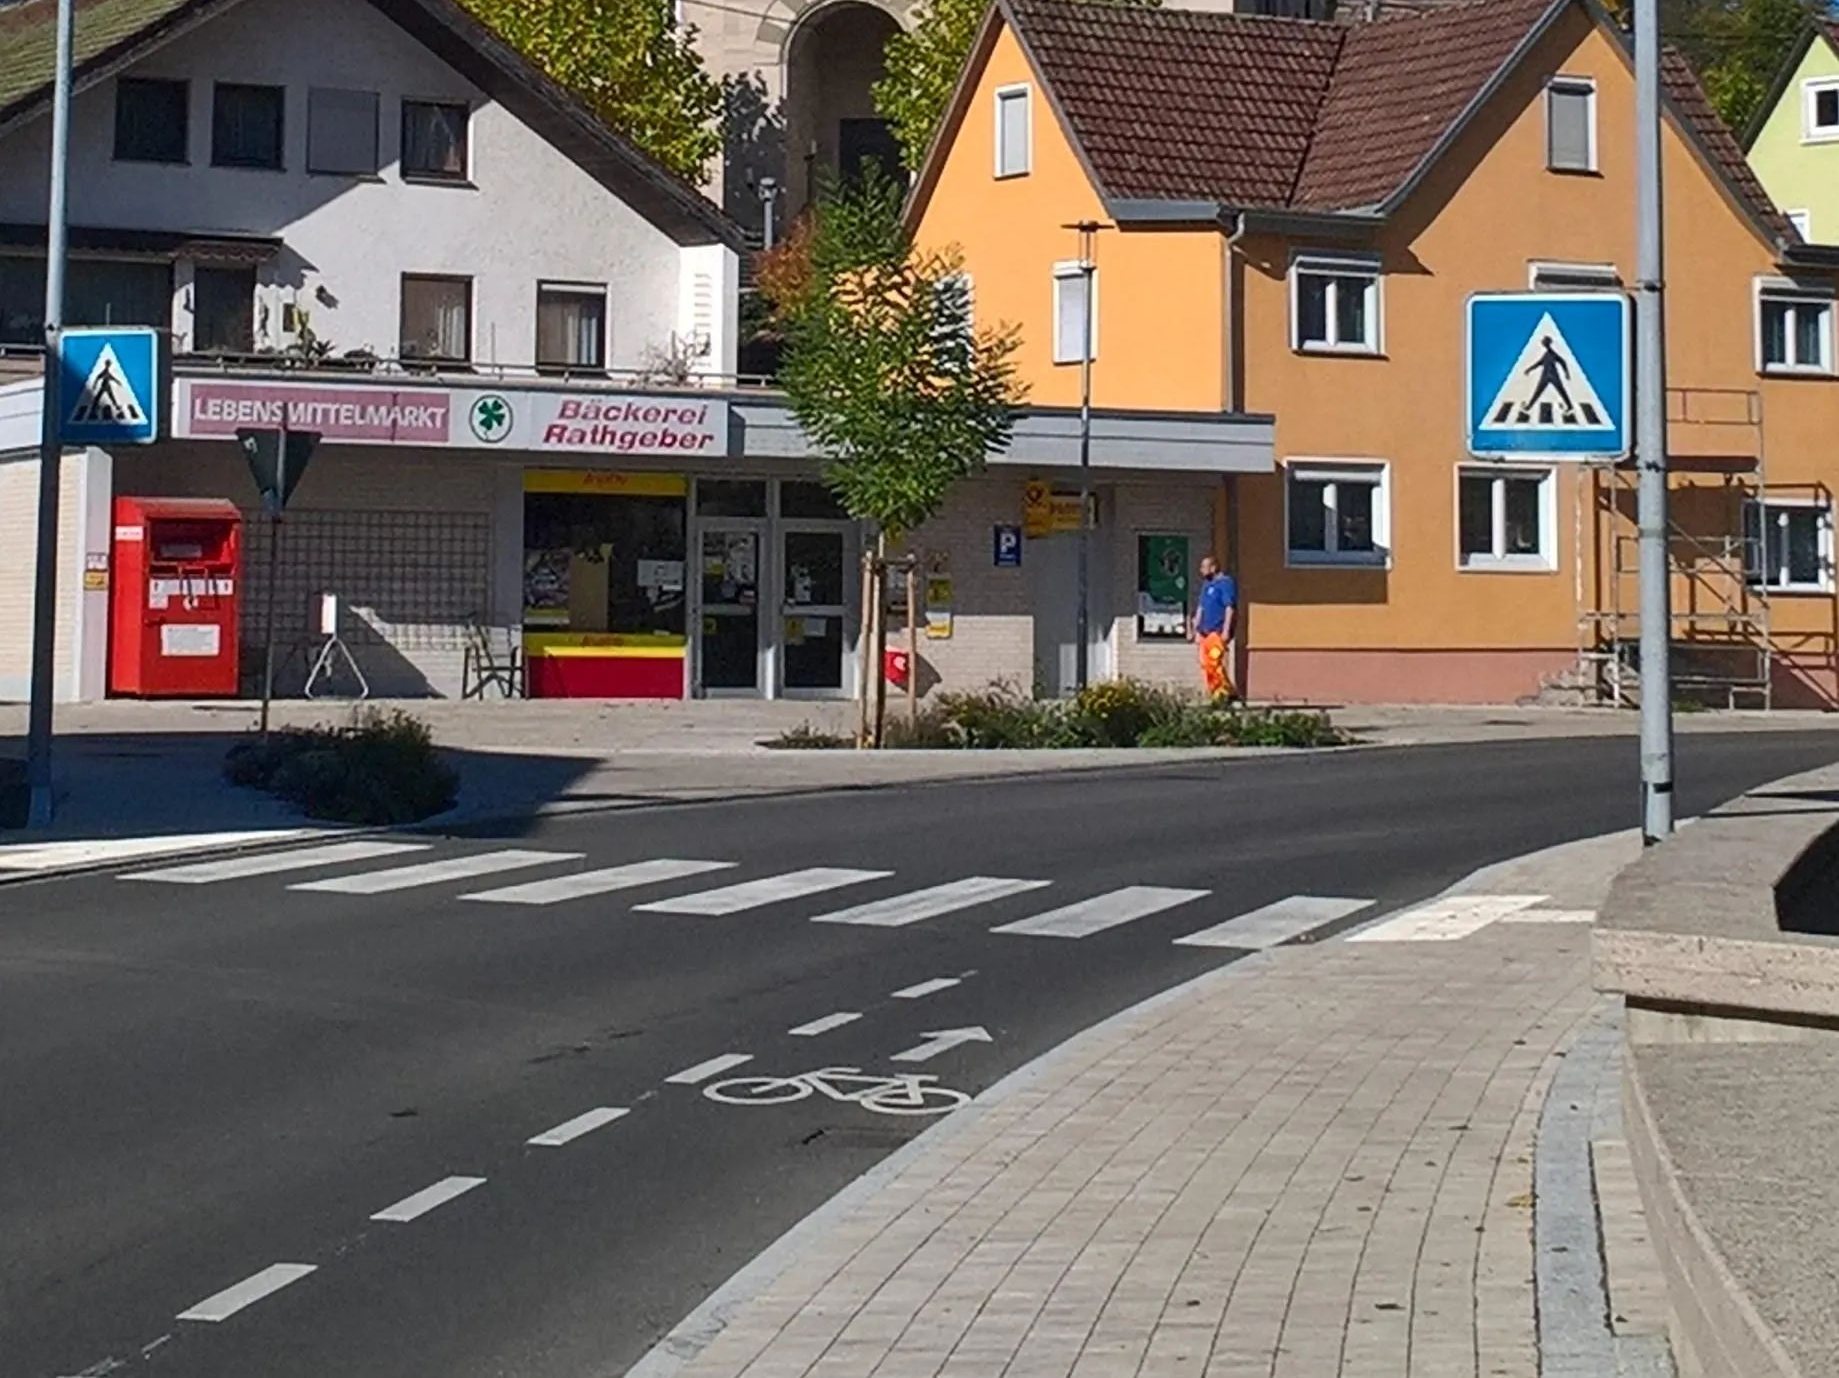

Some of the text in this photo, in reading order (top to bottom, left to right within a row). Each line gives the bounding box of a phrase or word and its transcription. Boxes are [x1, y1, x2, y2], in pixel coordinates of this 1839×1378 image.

[558, 399, 709, 425] Bäckerei
[543, 424, 714, 450] Rathgeber
[1000, 533, 1016, 553] P
